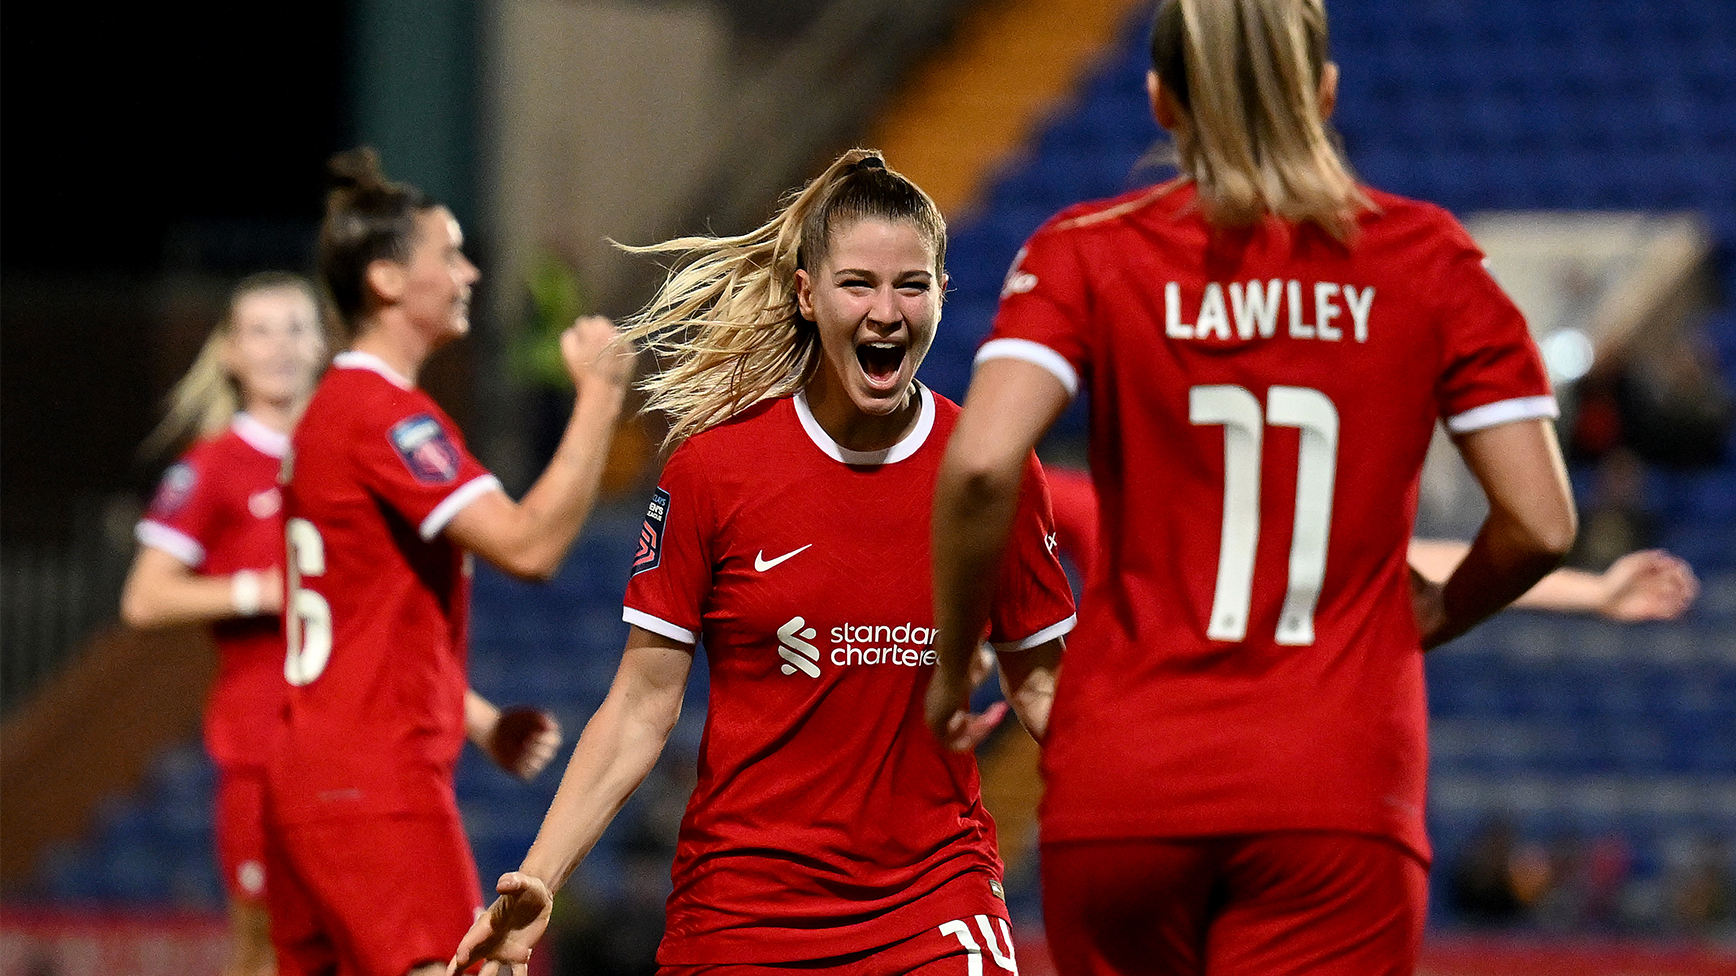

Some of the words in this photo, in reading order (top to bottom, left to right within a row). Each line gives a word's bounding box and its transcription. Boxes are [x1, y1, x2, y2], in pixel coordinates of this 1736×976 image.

[1165, 278, 1376, 343] LAWLEY
[1188, 383, 1340, 646] 11
[284, 517, 333, 687] 6
[830, 644, 941, 667] chartere
[938, 914, 1019, 976] 14
